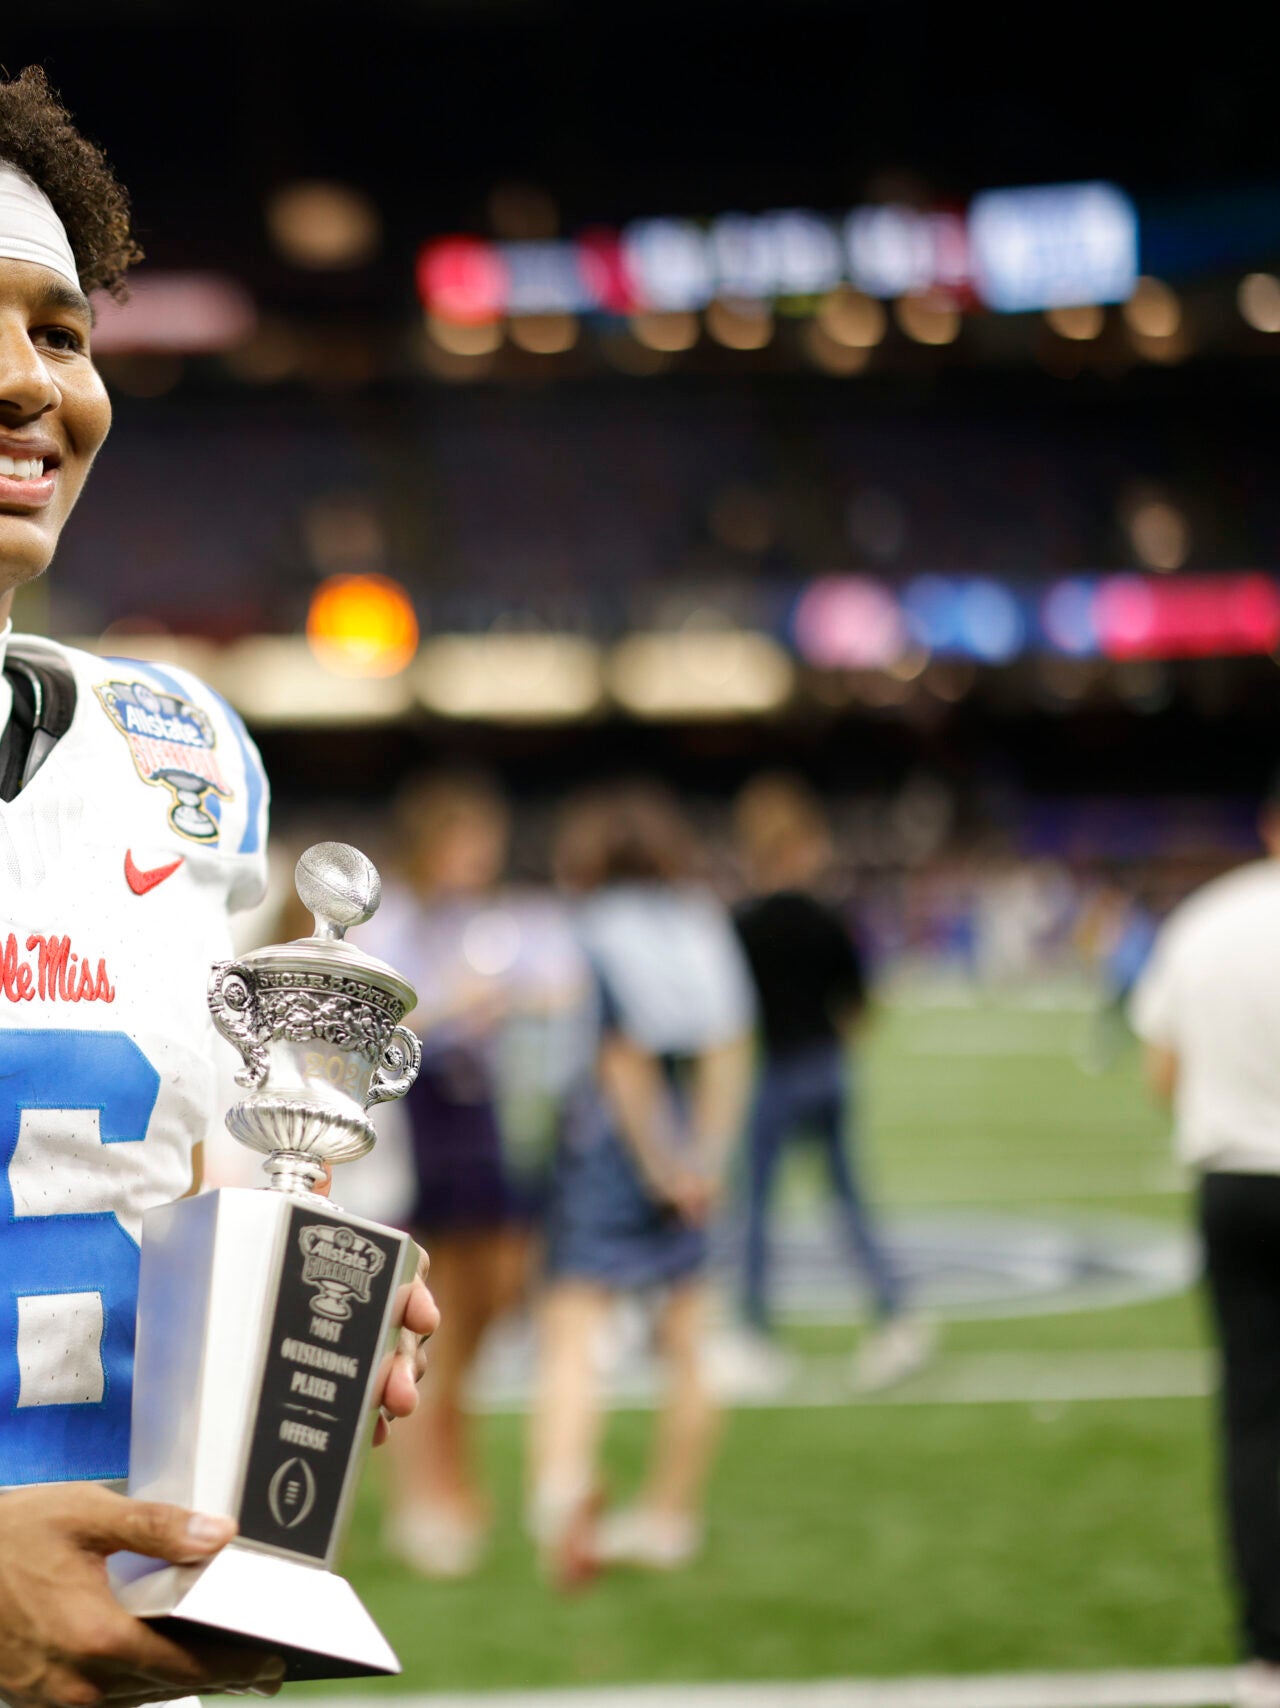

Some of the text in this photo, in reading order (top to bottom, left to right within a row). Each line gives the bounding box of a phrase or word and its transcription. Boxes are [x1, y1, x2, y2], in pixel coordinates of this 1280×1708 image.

[25, 934, 115, 1003] Miss
[259, 972, 387, 1007] SUGAR BOWL
[310, 1241, 368, 1271] Allstate
[308, 1315, 343, 1343] MOST
[280, 1337, 359, 1379] OUTSTANDING
[289, 1371, 337, 1402] PLAYER
[279, 1419, 330, 1452] OFFENSE
